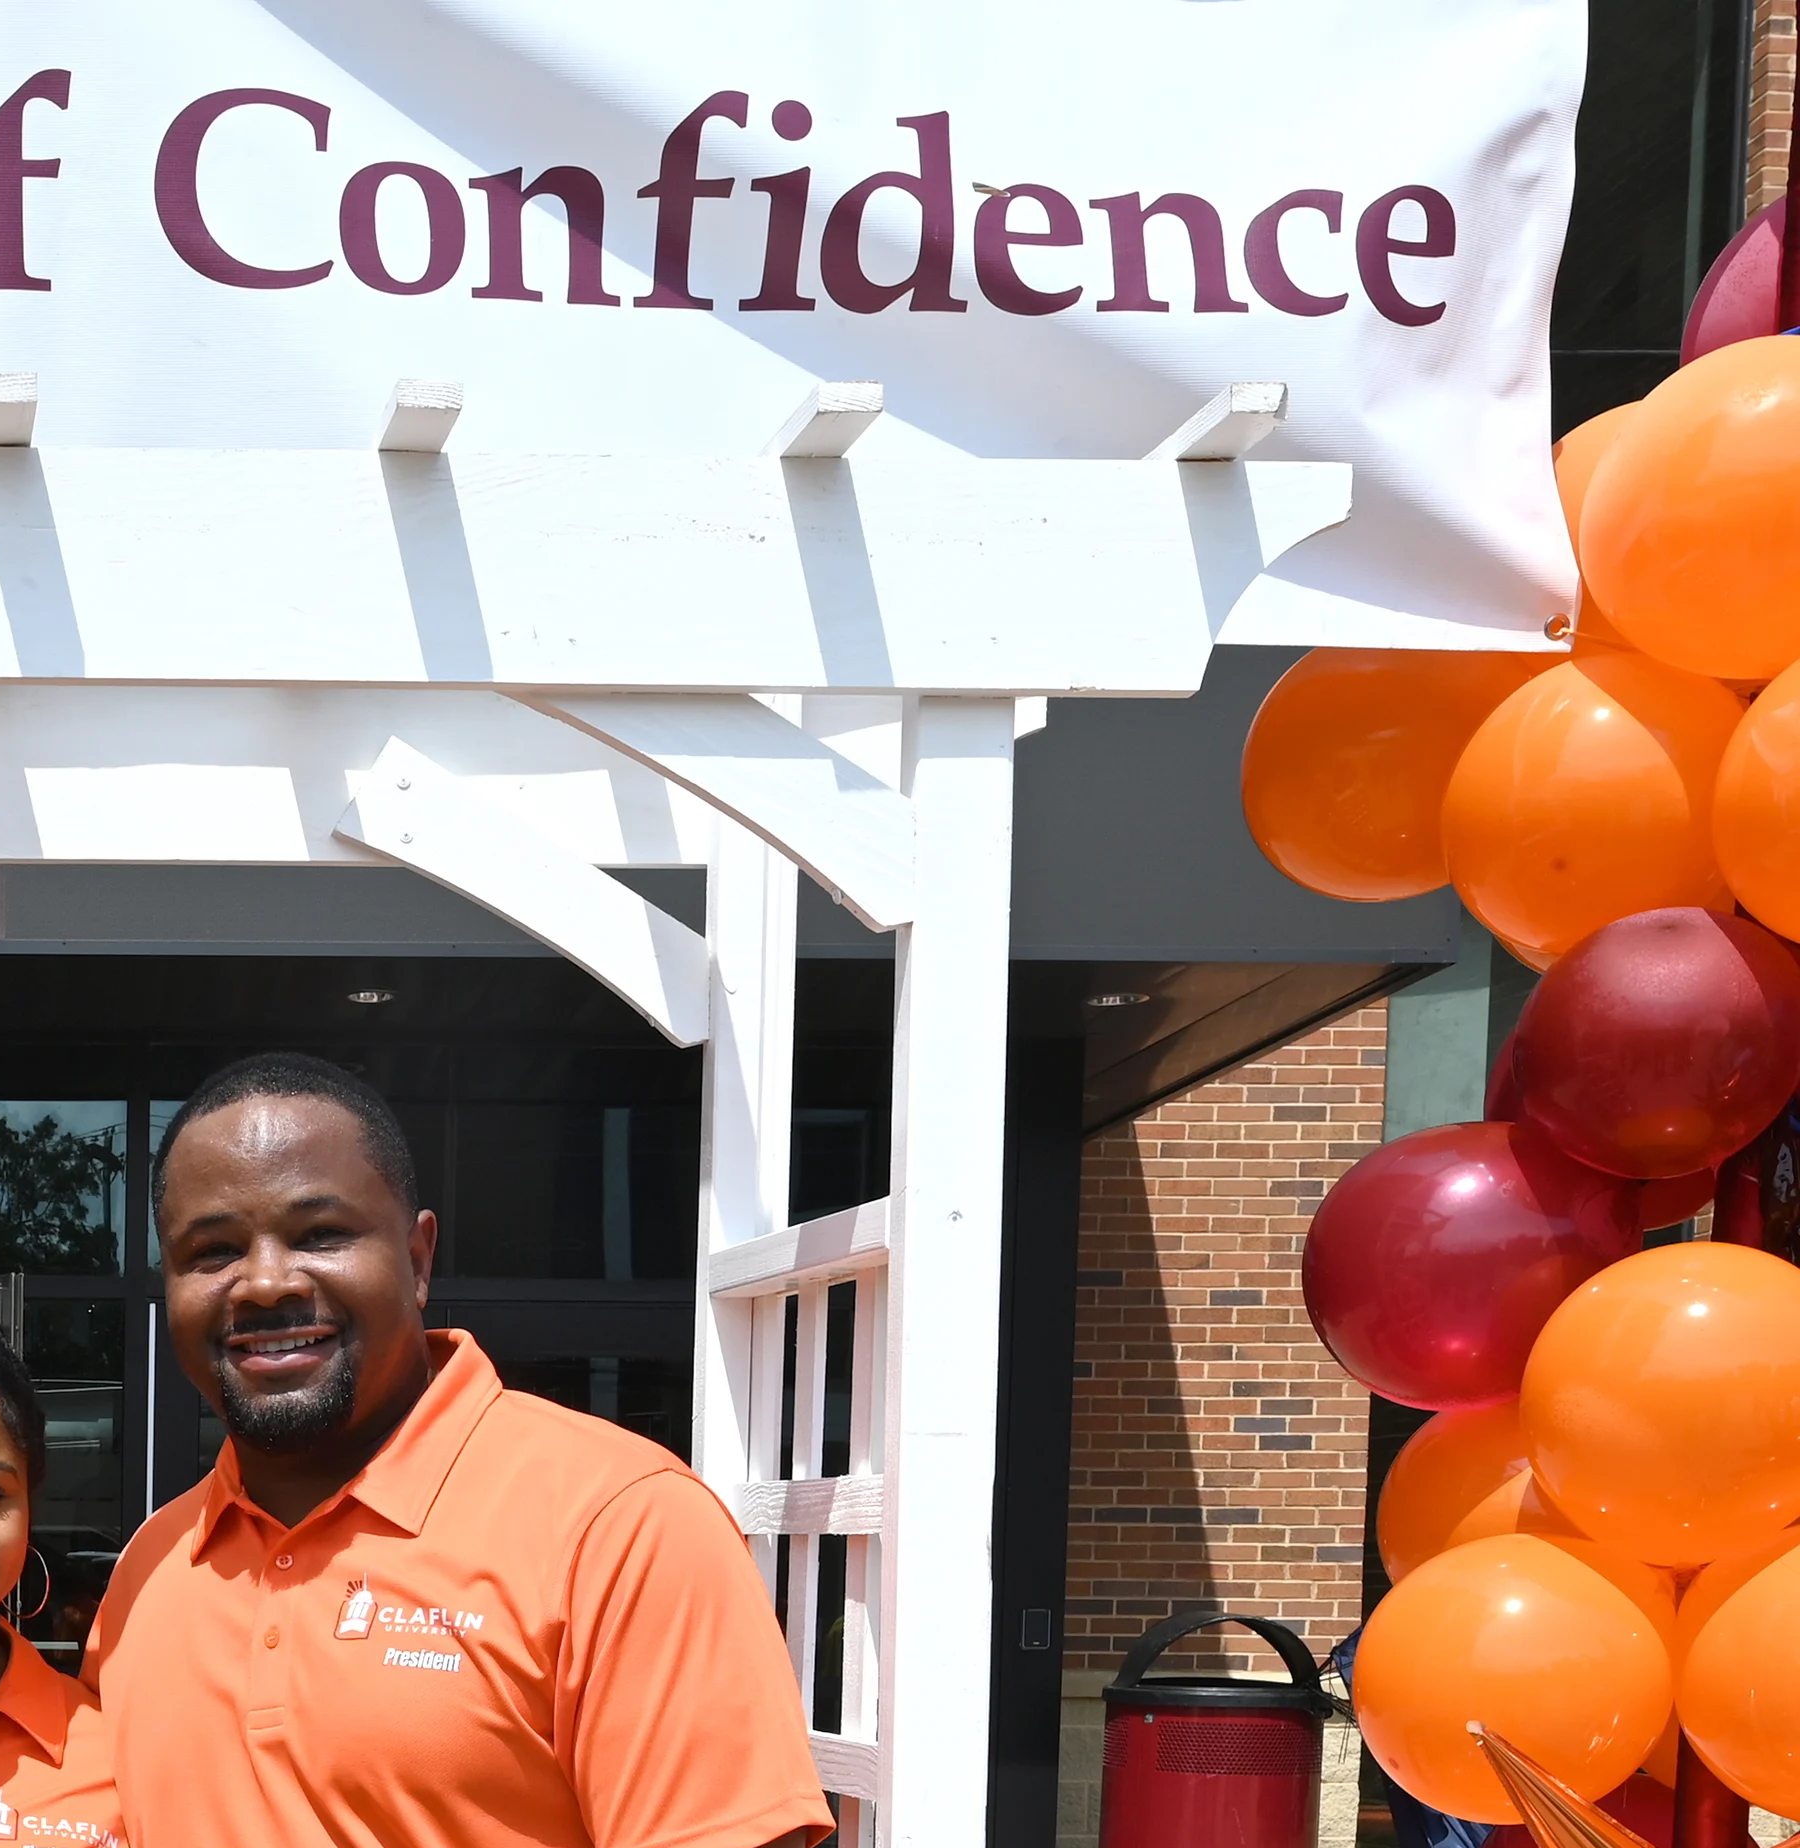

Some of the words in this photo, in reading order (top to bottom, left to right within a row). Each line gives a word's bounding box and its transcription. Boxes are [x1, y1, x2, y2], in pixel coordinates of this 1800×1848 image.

[153, 88, 1457, 328] Confidence
[379, 1607, 483, 1629] CLAFLIN
[384, 1648, 461, 1672] President
